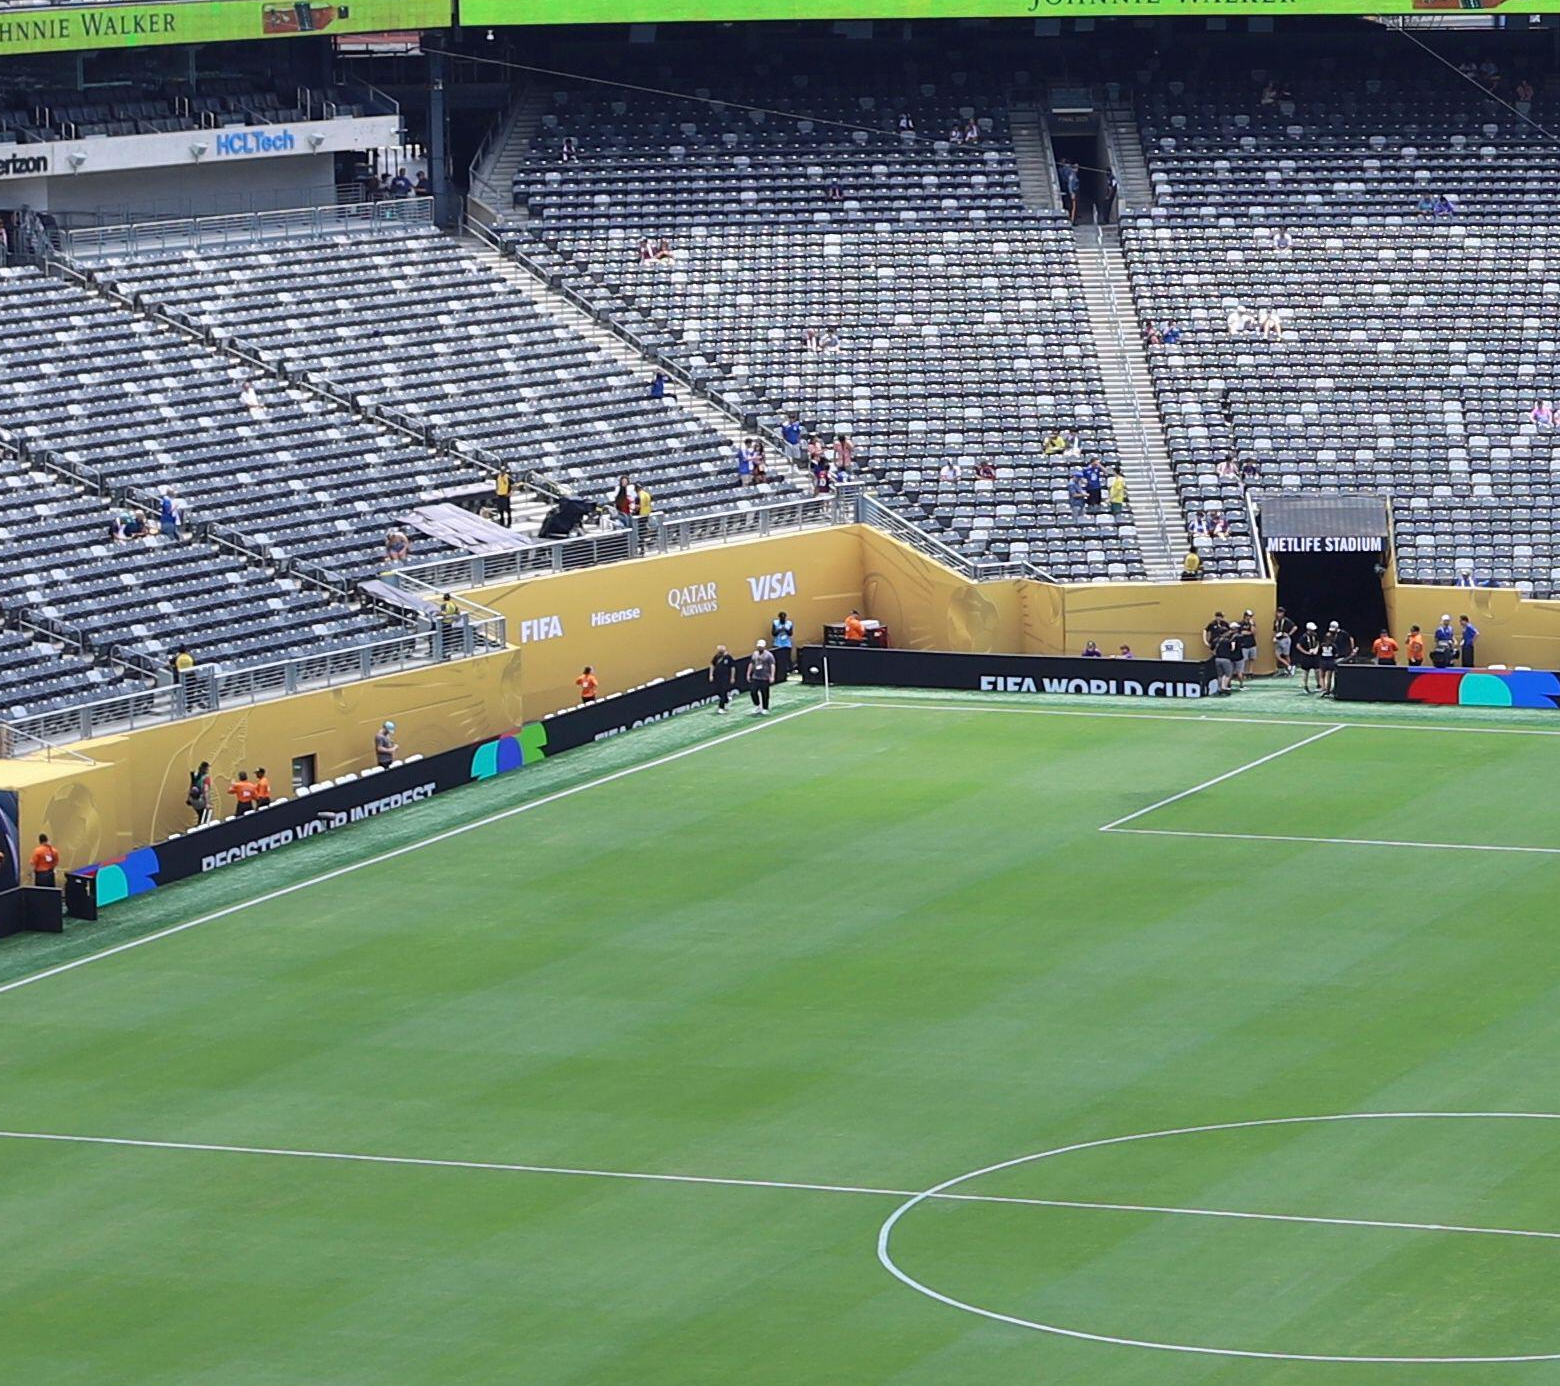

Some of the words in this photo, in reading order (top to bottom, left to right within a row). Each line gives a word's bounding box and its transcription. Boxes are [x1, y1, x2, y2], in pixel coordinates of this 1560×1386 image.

[81, 12, 176, 40] WALKER
[216, 130, 295, 154] HCLTech
[1266, 537, 1322, 552] METLIFE
[1325, 537, 1382, 552] STADIUM
[668, 581, 717, 609] QATAR
[746, 570, 796, 603] VISA
[590, 606, 641, 627] Hisense
[680, 600, 719, 617] AIRWAYS
[520, 614, 564, 644] FIFA
[980, 675, 1037, 693] FIFA
